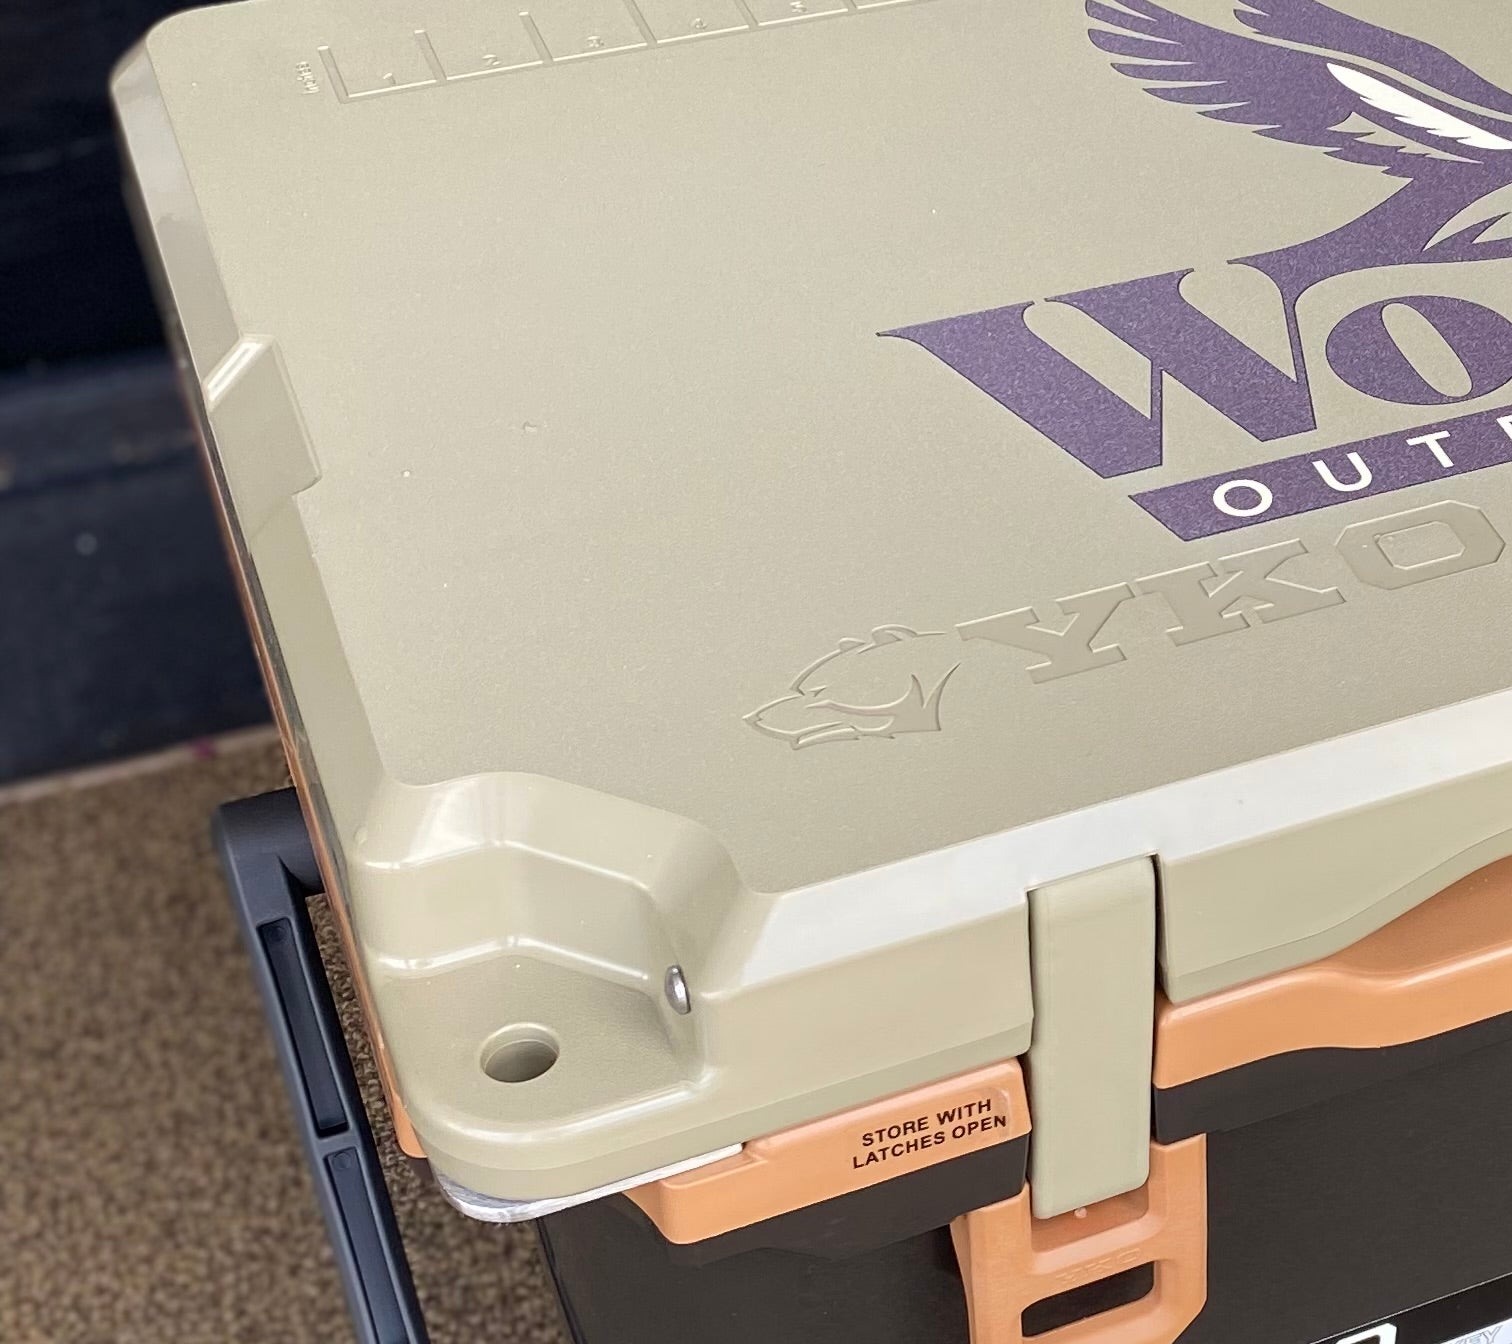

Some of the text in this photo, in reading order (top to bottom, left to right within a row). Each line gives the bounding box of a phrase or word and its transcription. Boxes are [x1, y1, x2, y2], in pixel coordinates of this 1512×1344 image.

[958, 499, 1508, 684] YKO
[852, 1113, 1007, 1170] LATCHES OPEN
[861, 1098, 993, 1147] STORE WITH
